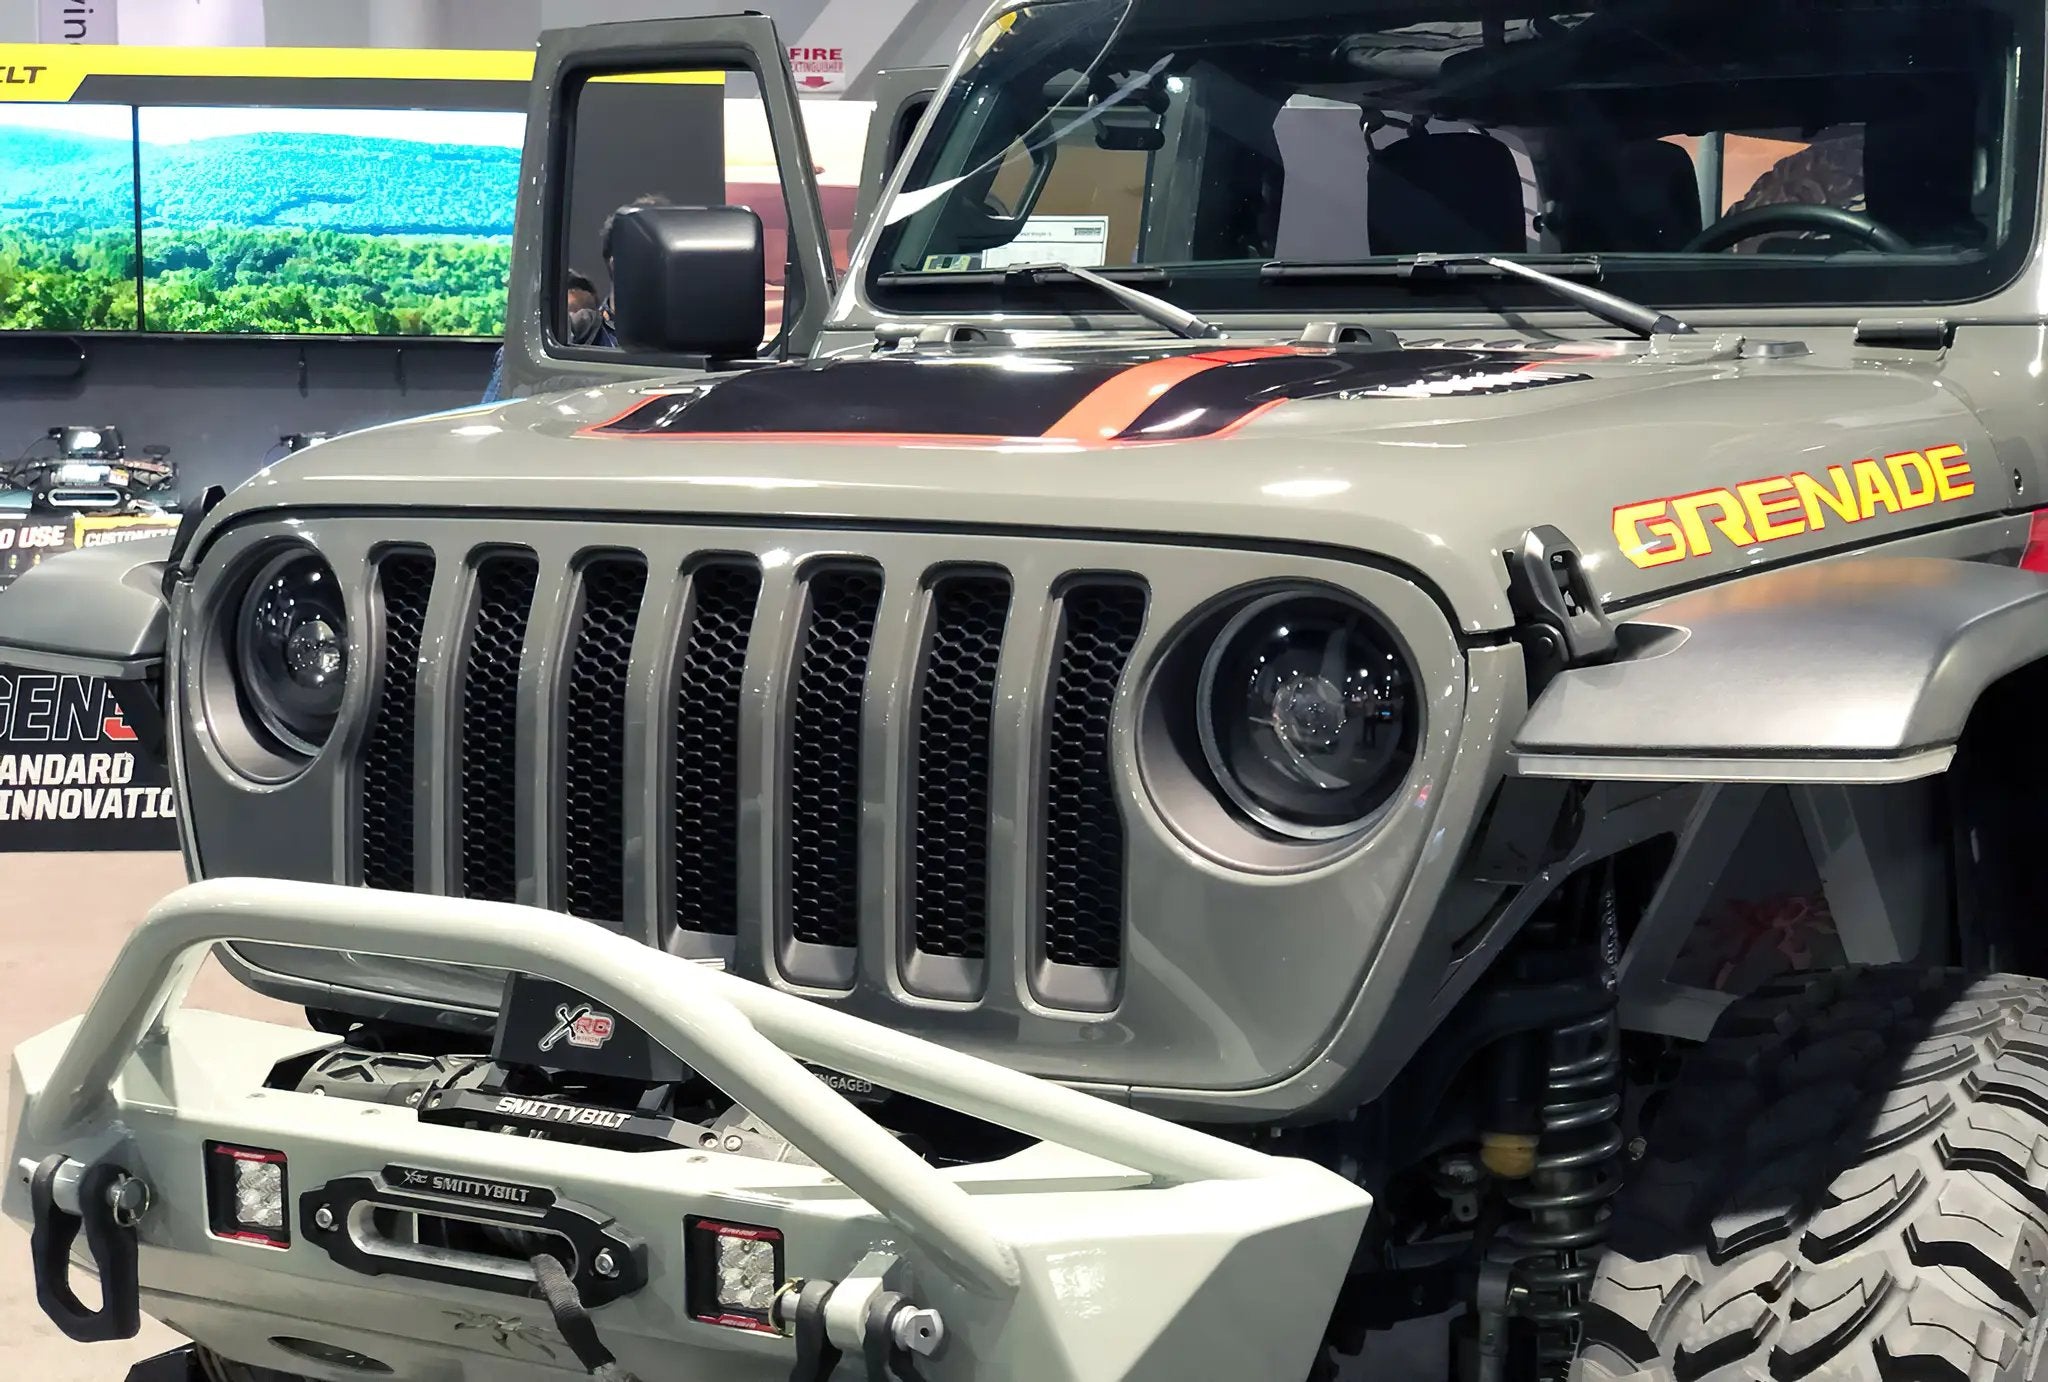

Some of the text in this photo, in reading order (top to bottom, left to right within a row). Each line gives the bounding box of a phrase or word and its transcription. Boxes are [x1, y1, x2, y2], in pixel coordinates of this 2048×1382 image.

[789, 47, 843, 61] FIRE
[1612, 443, 1976, 569] GRENADE
[18, 525, 67, 549] USE
[813, 1073, 872, 1093] NGAGED
[495, 1096, 632, 1129] SMITTYBILT
[432, 1176, 530, 1203] SMITTYBILT
